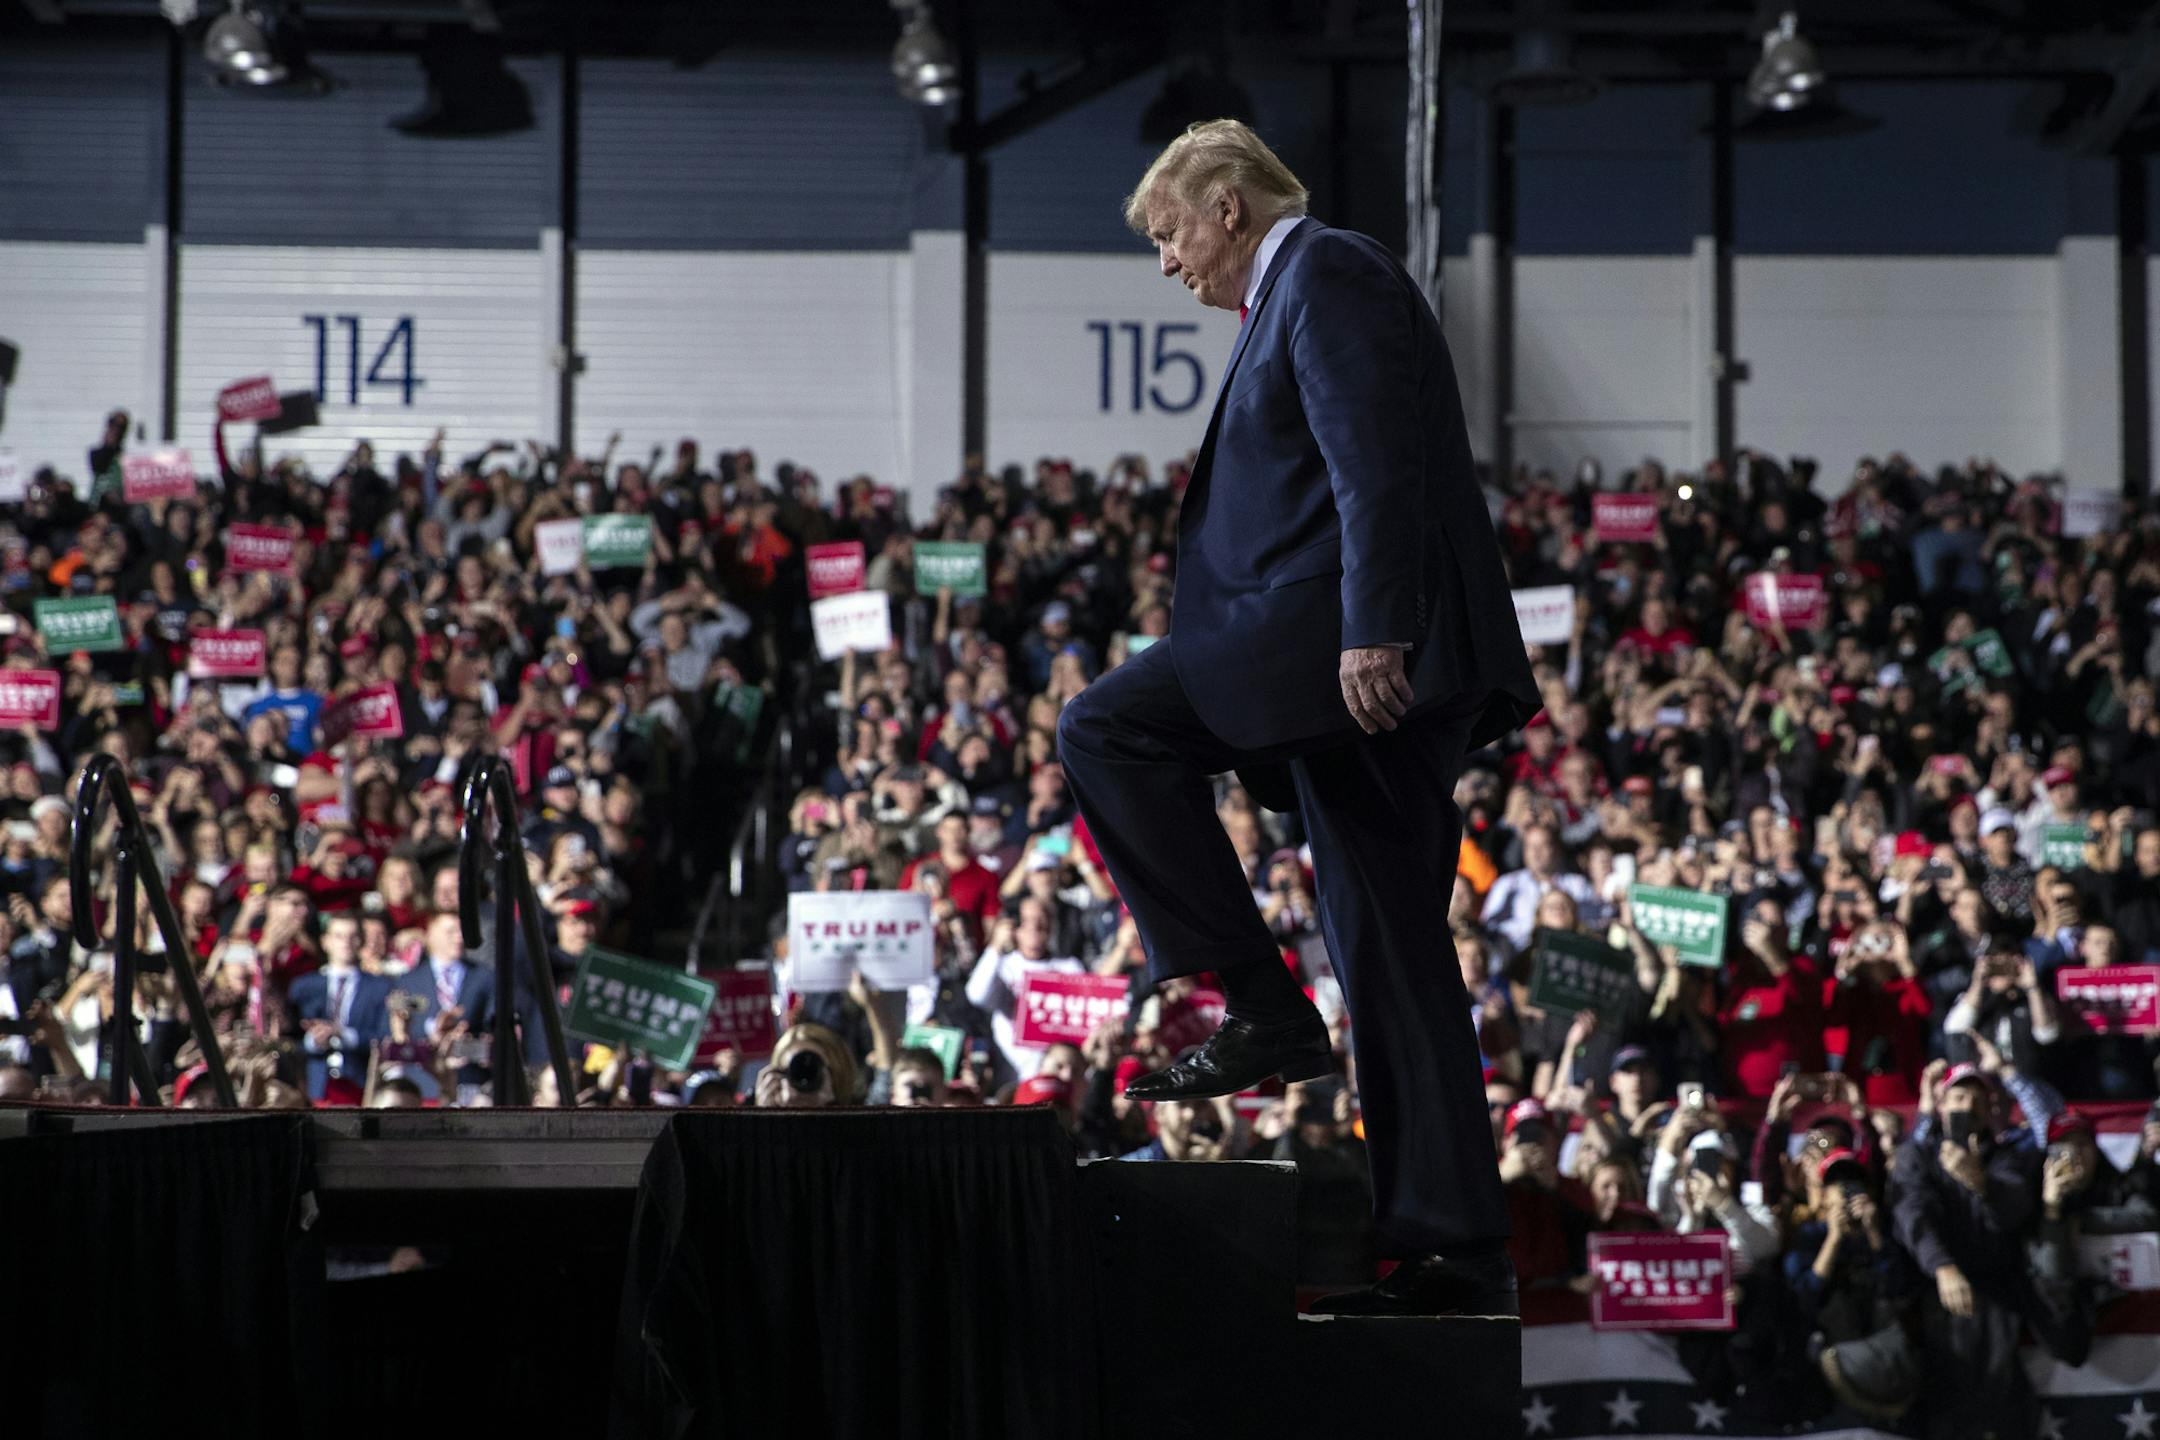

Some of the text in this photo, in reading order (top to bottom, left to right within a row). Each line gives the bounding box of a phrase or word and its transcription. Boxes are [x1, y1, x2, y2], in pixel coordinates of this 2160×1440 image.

[303, 315, 425, 405] 114
[1086, 322, 1205, 414] 115
[802, 920, 922, 938] TRUMP
[586, 973, 701, 1024] TRUMP
[1028, 991, 1130, 1017] TRUMP
[1030, 1008, 1102, 1029] PENC
[1597, 1258, 1724, 1282] TRUMP
[1608, 1280, 1712, 1297] PENCE
